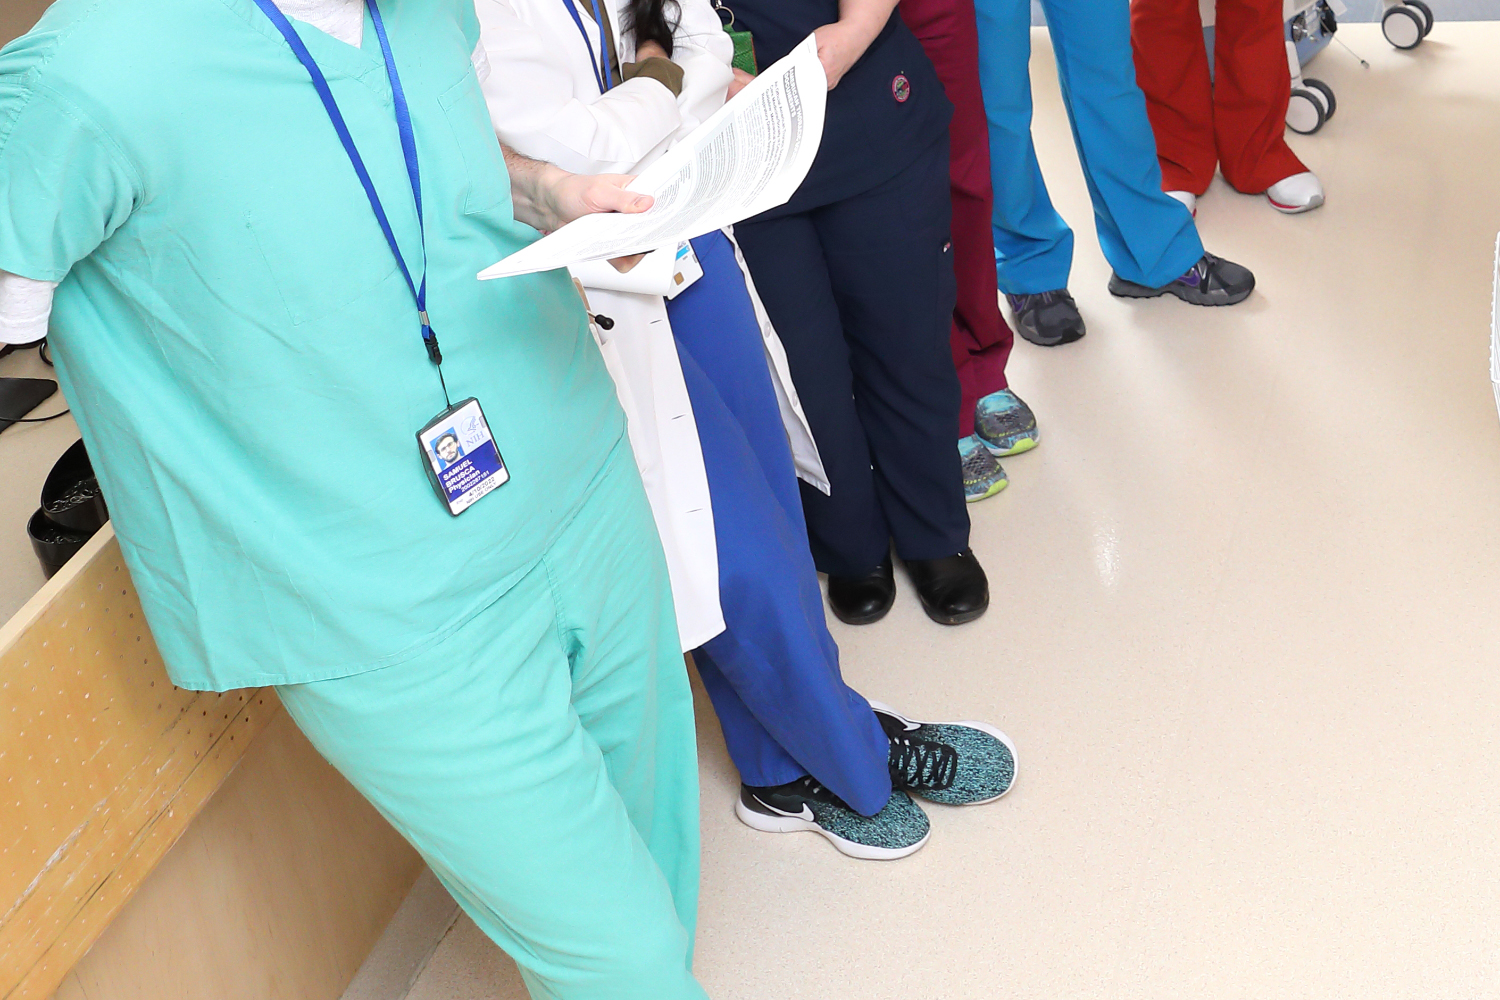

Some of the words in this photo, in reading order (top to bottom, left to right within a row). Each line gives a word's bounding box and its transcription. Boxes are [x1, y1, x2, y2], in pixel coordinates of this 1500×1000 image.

[784, 72, 797, 118] DOCUMENTS
[789, 68, 801, 106] AMERICAN
[466, 431, 485, 448] NIH
[443, 459, 473, 481] SAMUEL
[445, 466, 476, 488] BRUSCA
[448, 470, 481, 494] Physician
[475, 489, 484, 501] USE
[484, 481, 497, 495] ONLY
